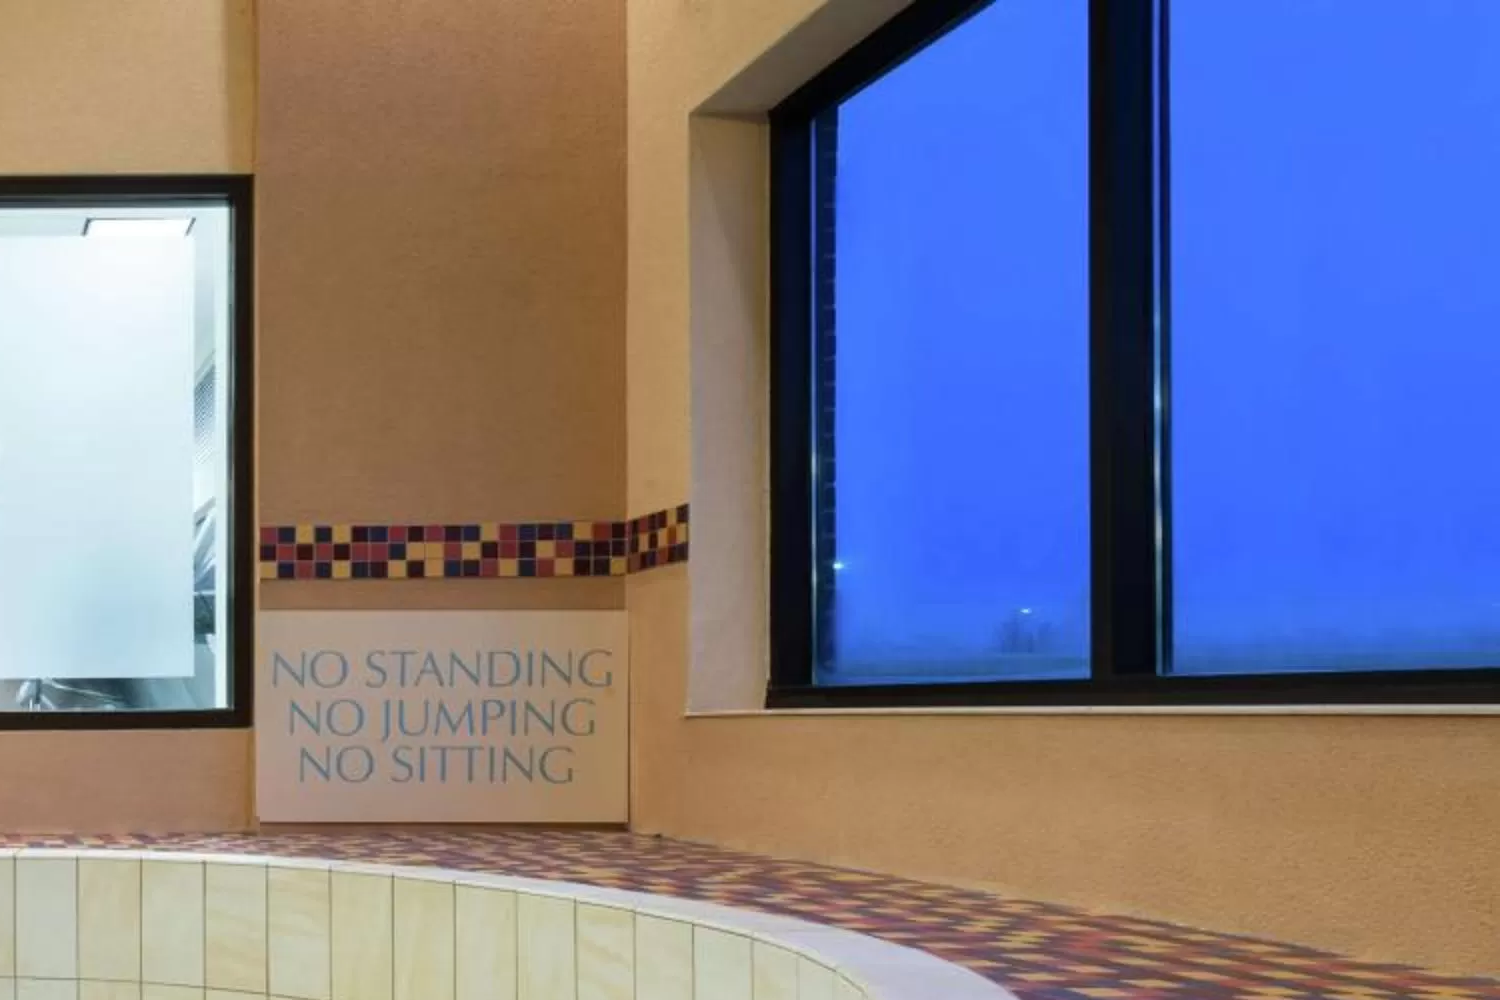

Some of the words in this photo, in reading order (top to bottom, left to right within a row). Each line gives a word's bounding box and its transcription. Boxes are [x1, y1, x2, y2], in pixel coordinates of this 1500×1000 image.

[272, 650, 348, 688] NO
[365, 649, 613, 688] STANDING
[289, 699, 365, 736] NO
[381, 699, 595, 742] JUMPING
[299, 746, 374, 782] NO
[391, 746, 575, 783] SITTING
